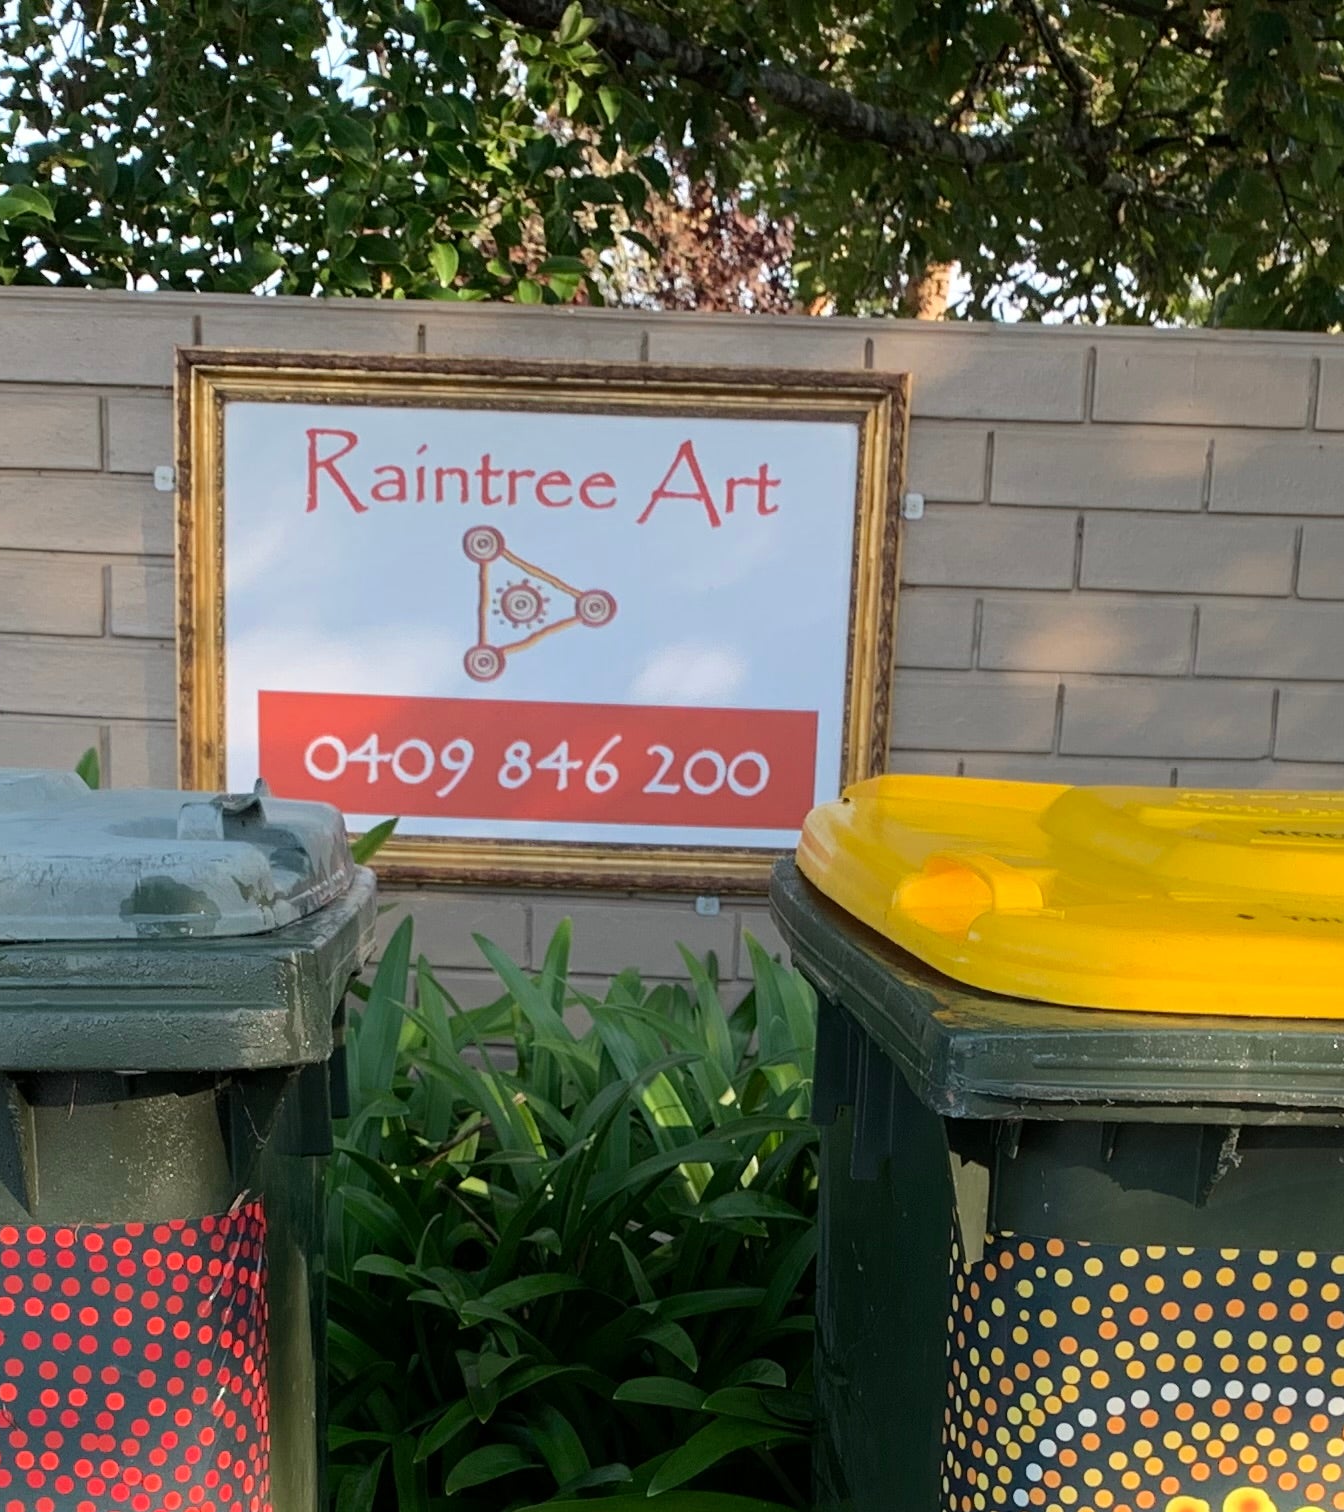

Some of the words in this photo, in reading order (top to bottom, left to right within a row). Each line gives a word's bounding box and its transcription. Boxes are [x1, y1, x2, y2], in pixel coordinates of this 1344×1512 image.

[304, 427, 618, 514] Raintree
[636, 438, 782, 529] Art
[304, 732, 475, 798] 0409
[497, 734, 623, 794] 846
[642, 743, 771, 797] 200
